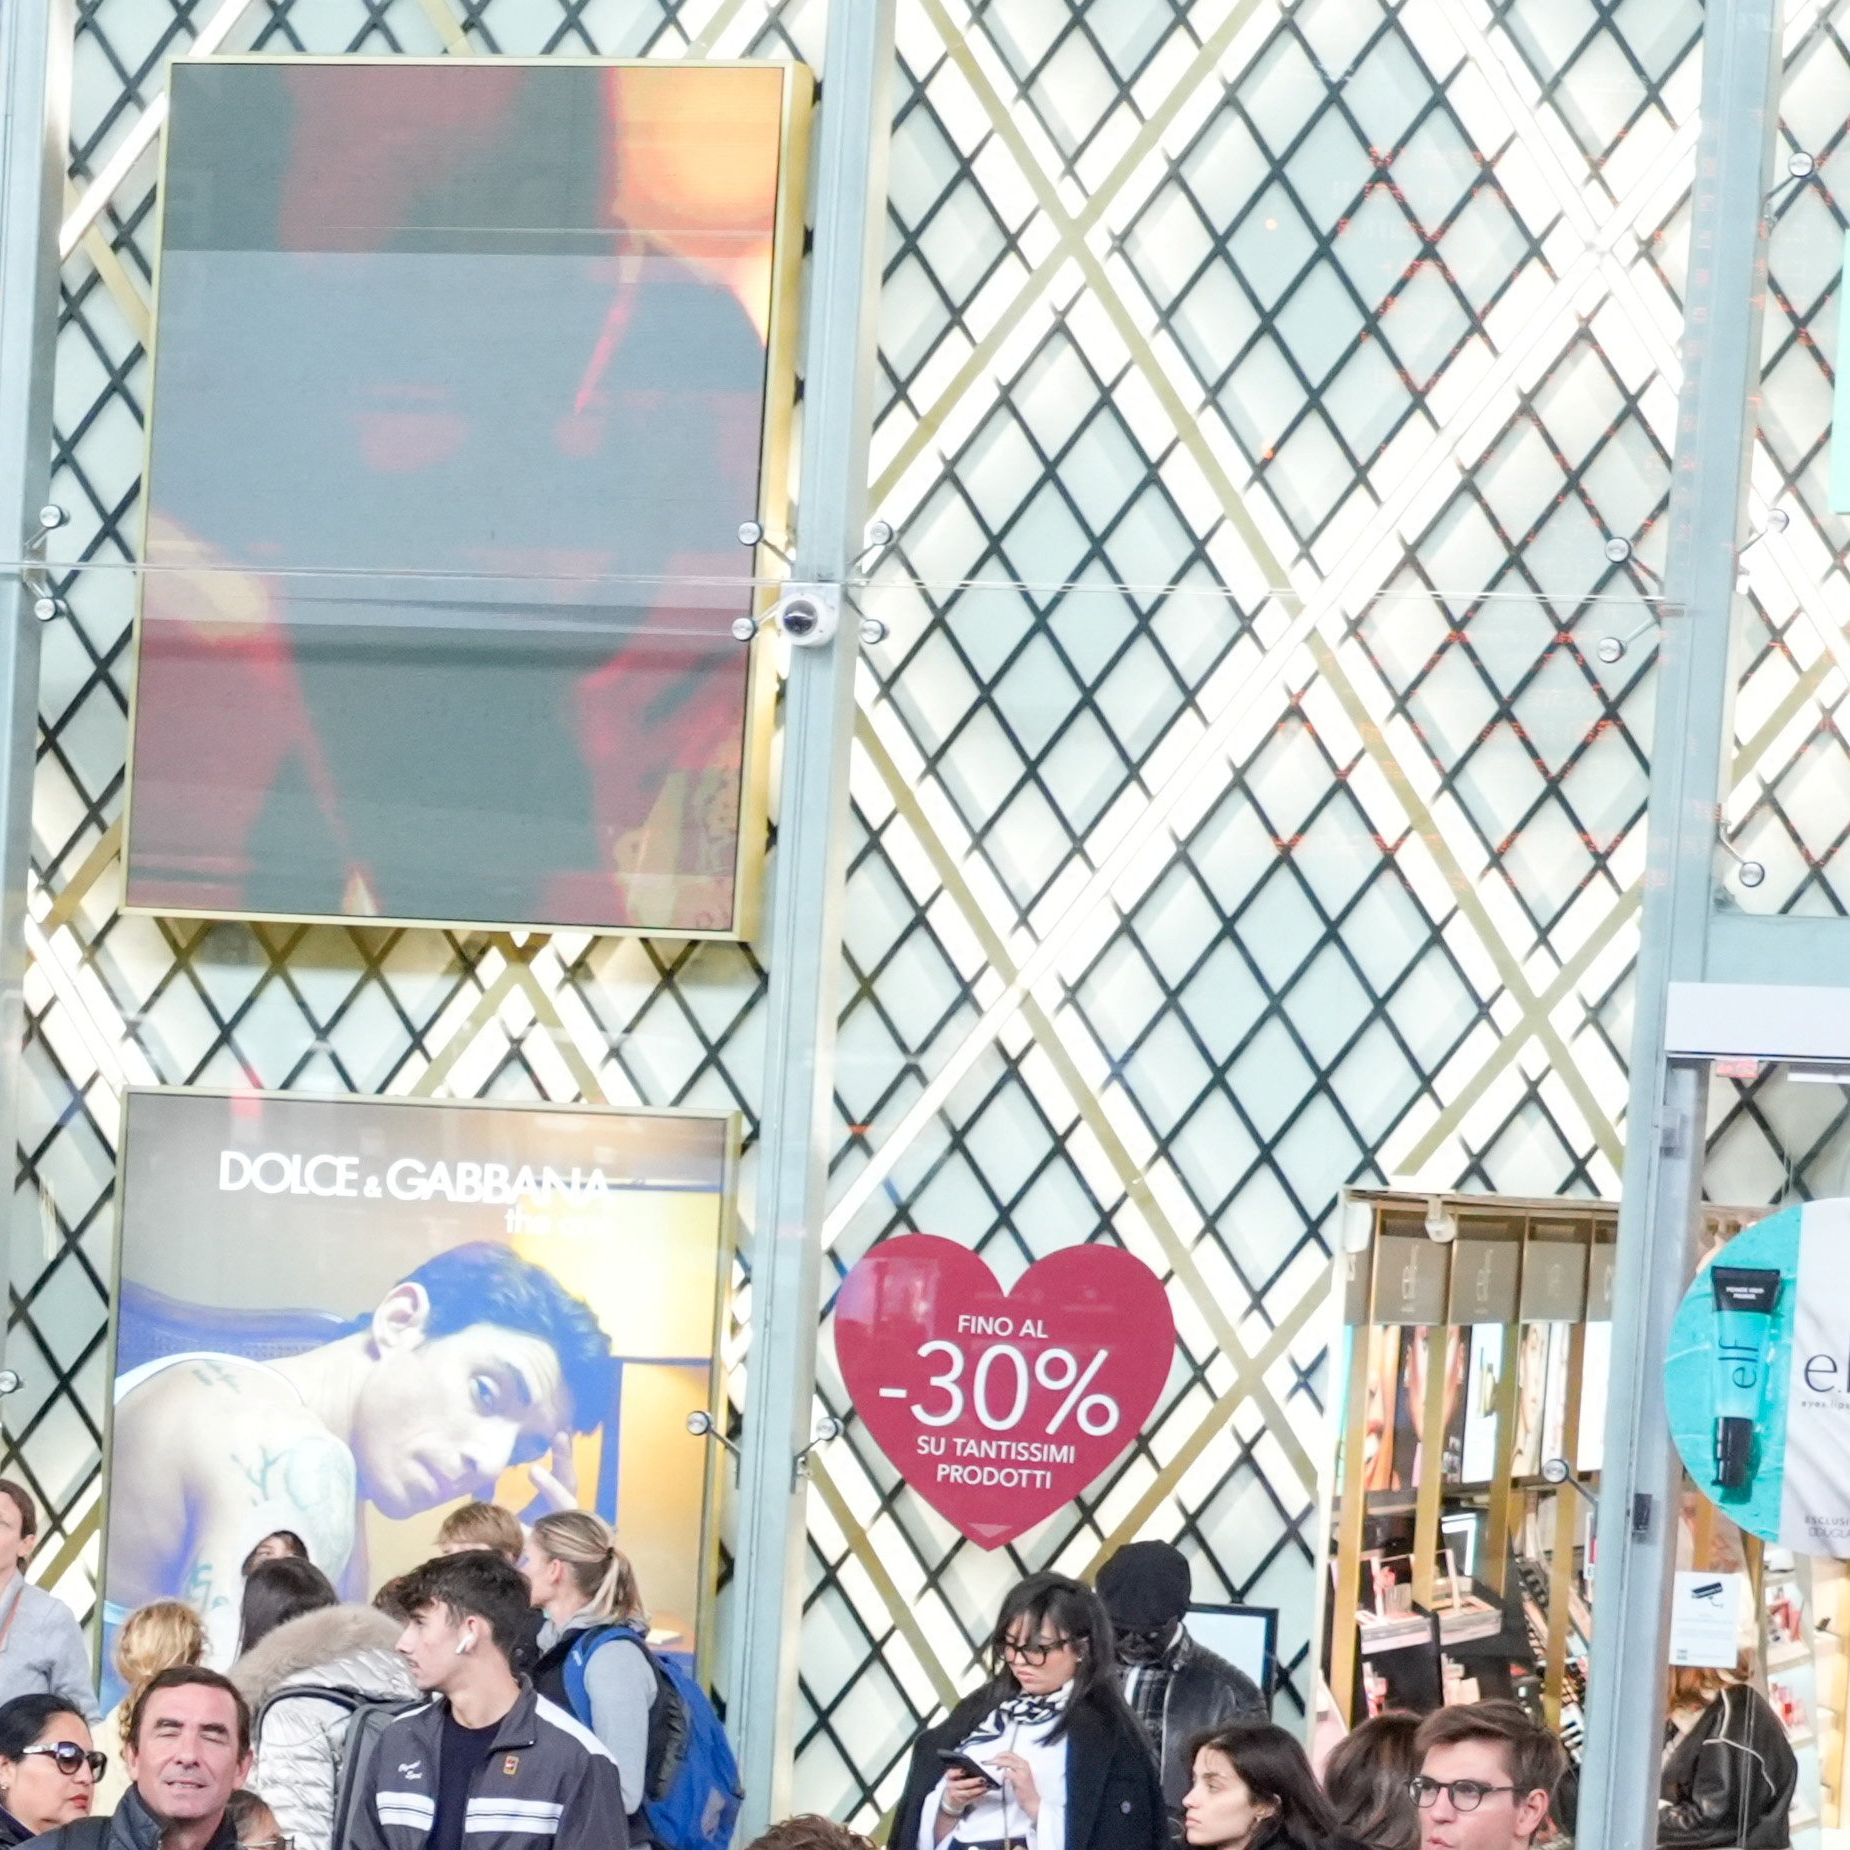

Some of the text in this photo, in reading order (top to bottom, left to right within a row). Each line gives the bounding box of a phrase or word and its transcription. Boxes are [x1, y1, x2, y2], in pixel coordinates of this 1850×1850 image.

[218, 1150, 615, 1206] DOLCE & GABBANA
[957, 1314, 1049, 1339] FINO AL
[879, 1339, 1120, 1436] -30%
[916, 1435, 1075, 1464] SU TANTISSIMI
[936, 1464, 1052, 1489] PRODOTTI
